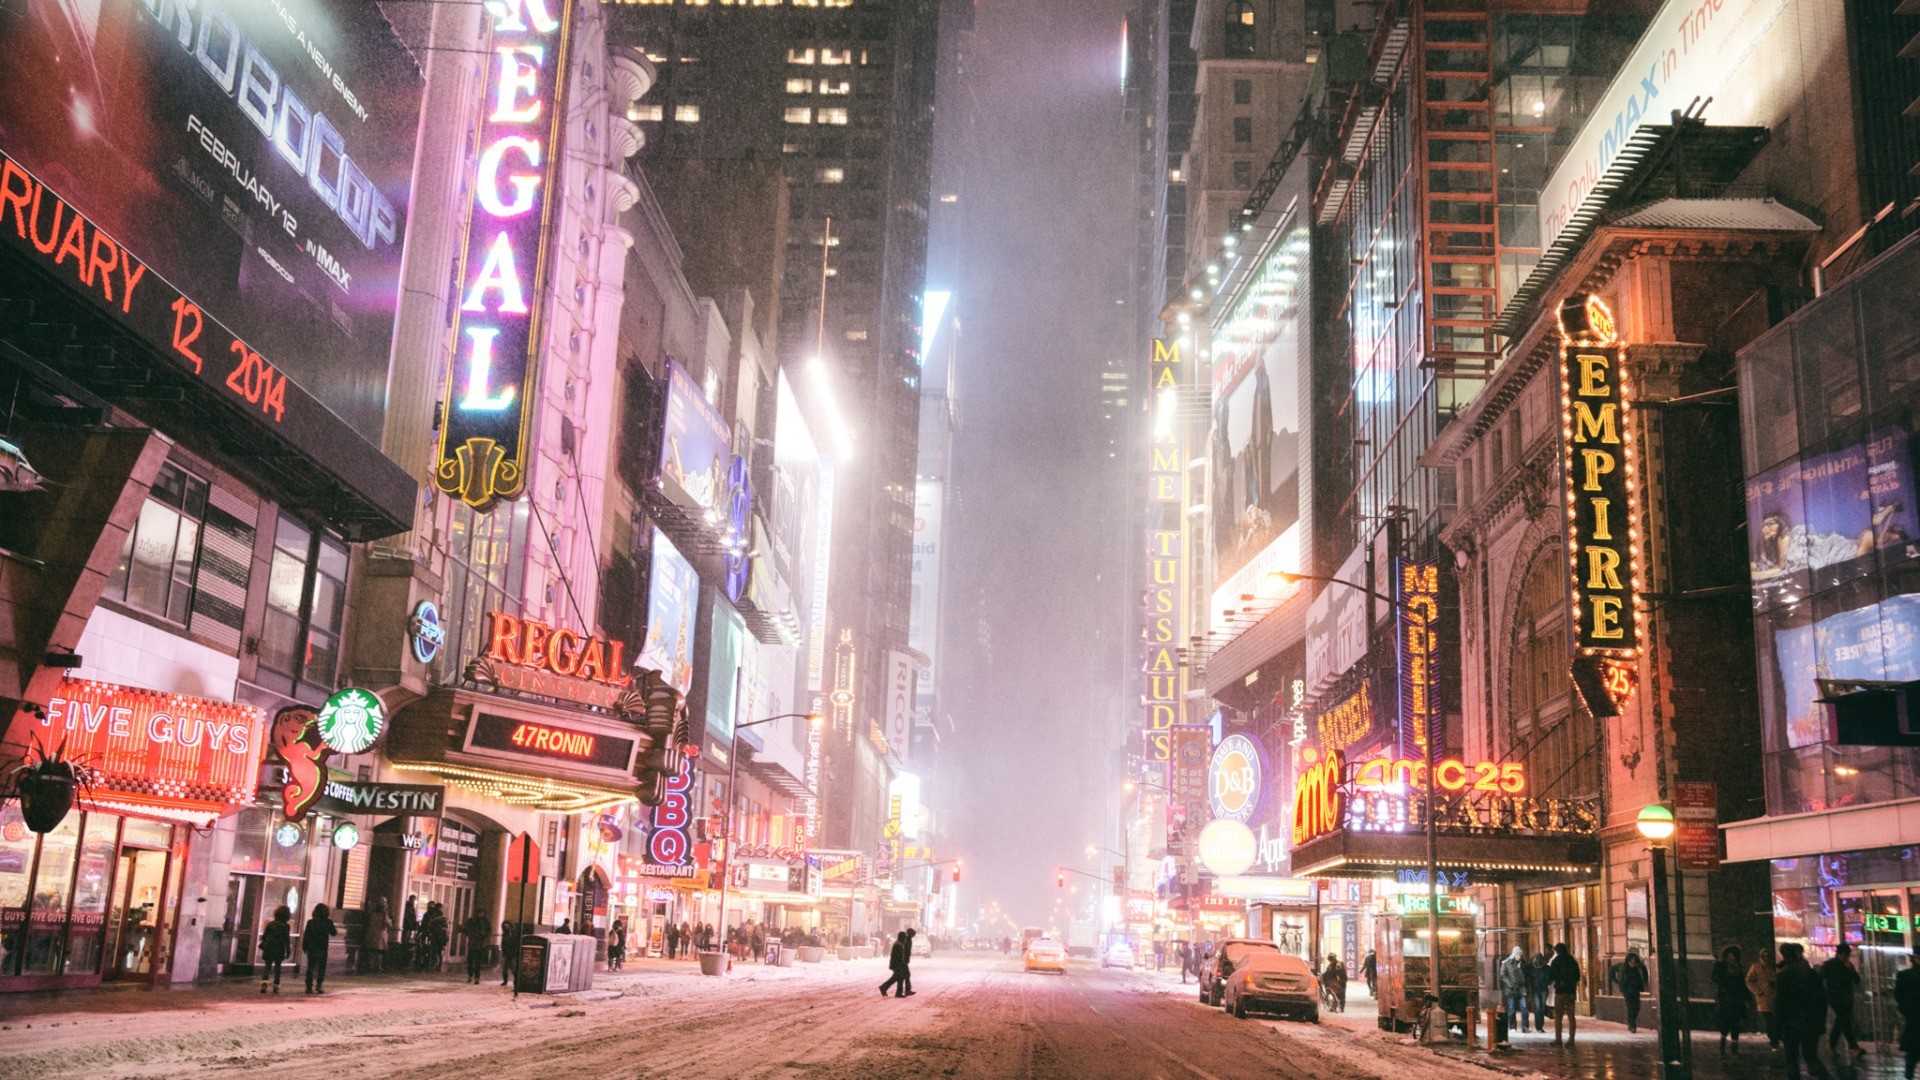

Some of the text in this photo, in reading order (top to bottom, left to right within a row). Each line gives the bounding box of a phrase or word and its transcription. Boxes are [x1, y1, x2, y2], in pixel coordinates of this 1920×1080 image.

[297, 31, 305, 48] A
[307, 41, 333, 79] NEW
[333, 73, 369, 122] ENEMY
[1546, 204, 1567, 242] The
[1569, 159, 1598, 213] Only
[1599, 62, 1659, 173] IMAX
[1662, 50, 1676, 84] in
[187, 114, 281, 217] FEBRUARY
[282, 209, 297, 238] 12
[306, 238, 349, 289] IN IMAX
[1590, 306, 1612, 338] amc
[225, 339, 286, 422] 2014
[1573, 355, 1624, 639] EMPIRE
[1152, 340, 1181, 760] MAAME TUSSAUD'S
[488, 611, 632, 687] REGAL
[501, 666, 616, 707] CINEMAS
[1608, 667, 1630, 695] 25
[41, 697, 249, 755] FIVE GUYS
[512, 724, 595, 757] 47RONIN
[1235, 740, 1254, 761] AND
[1180, 777, 1202, 786] Dink
[1214, 767, 1255, 799] D&B
[1355, 757, 1525, 792] amc 25
[352, 786, 438, 811] WESTIN
[1180, 786, 1202, 797] Pay
[1292, 748, 1340, 846] amc
[640, 864, 694, 877] RESTAURANT
[1398, 870, 1469, 887] IMAX
[5, 911, 26, 922] GUYS
[31, 911, 67, 924] FIVE GUYS
[71, 914, 105, 925] FIVE GUYS
